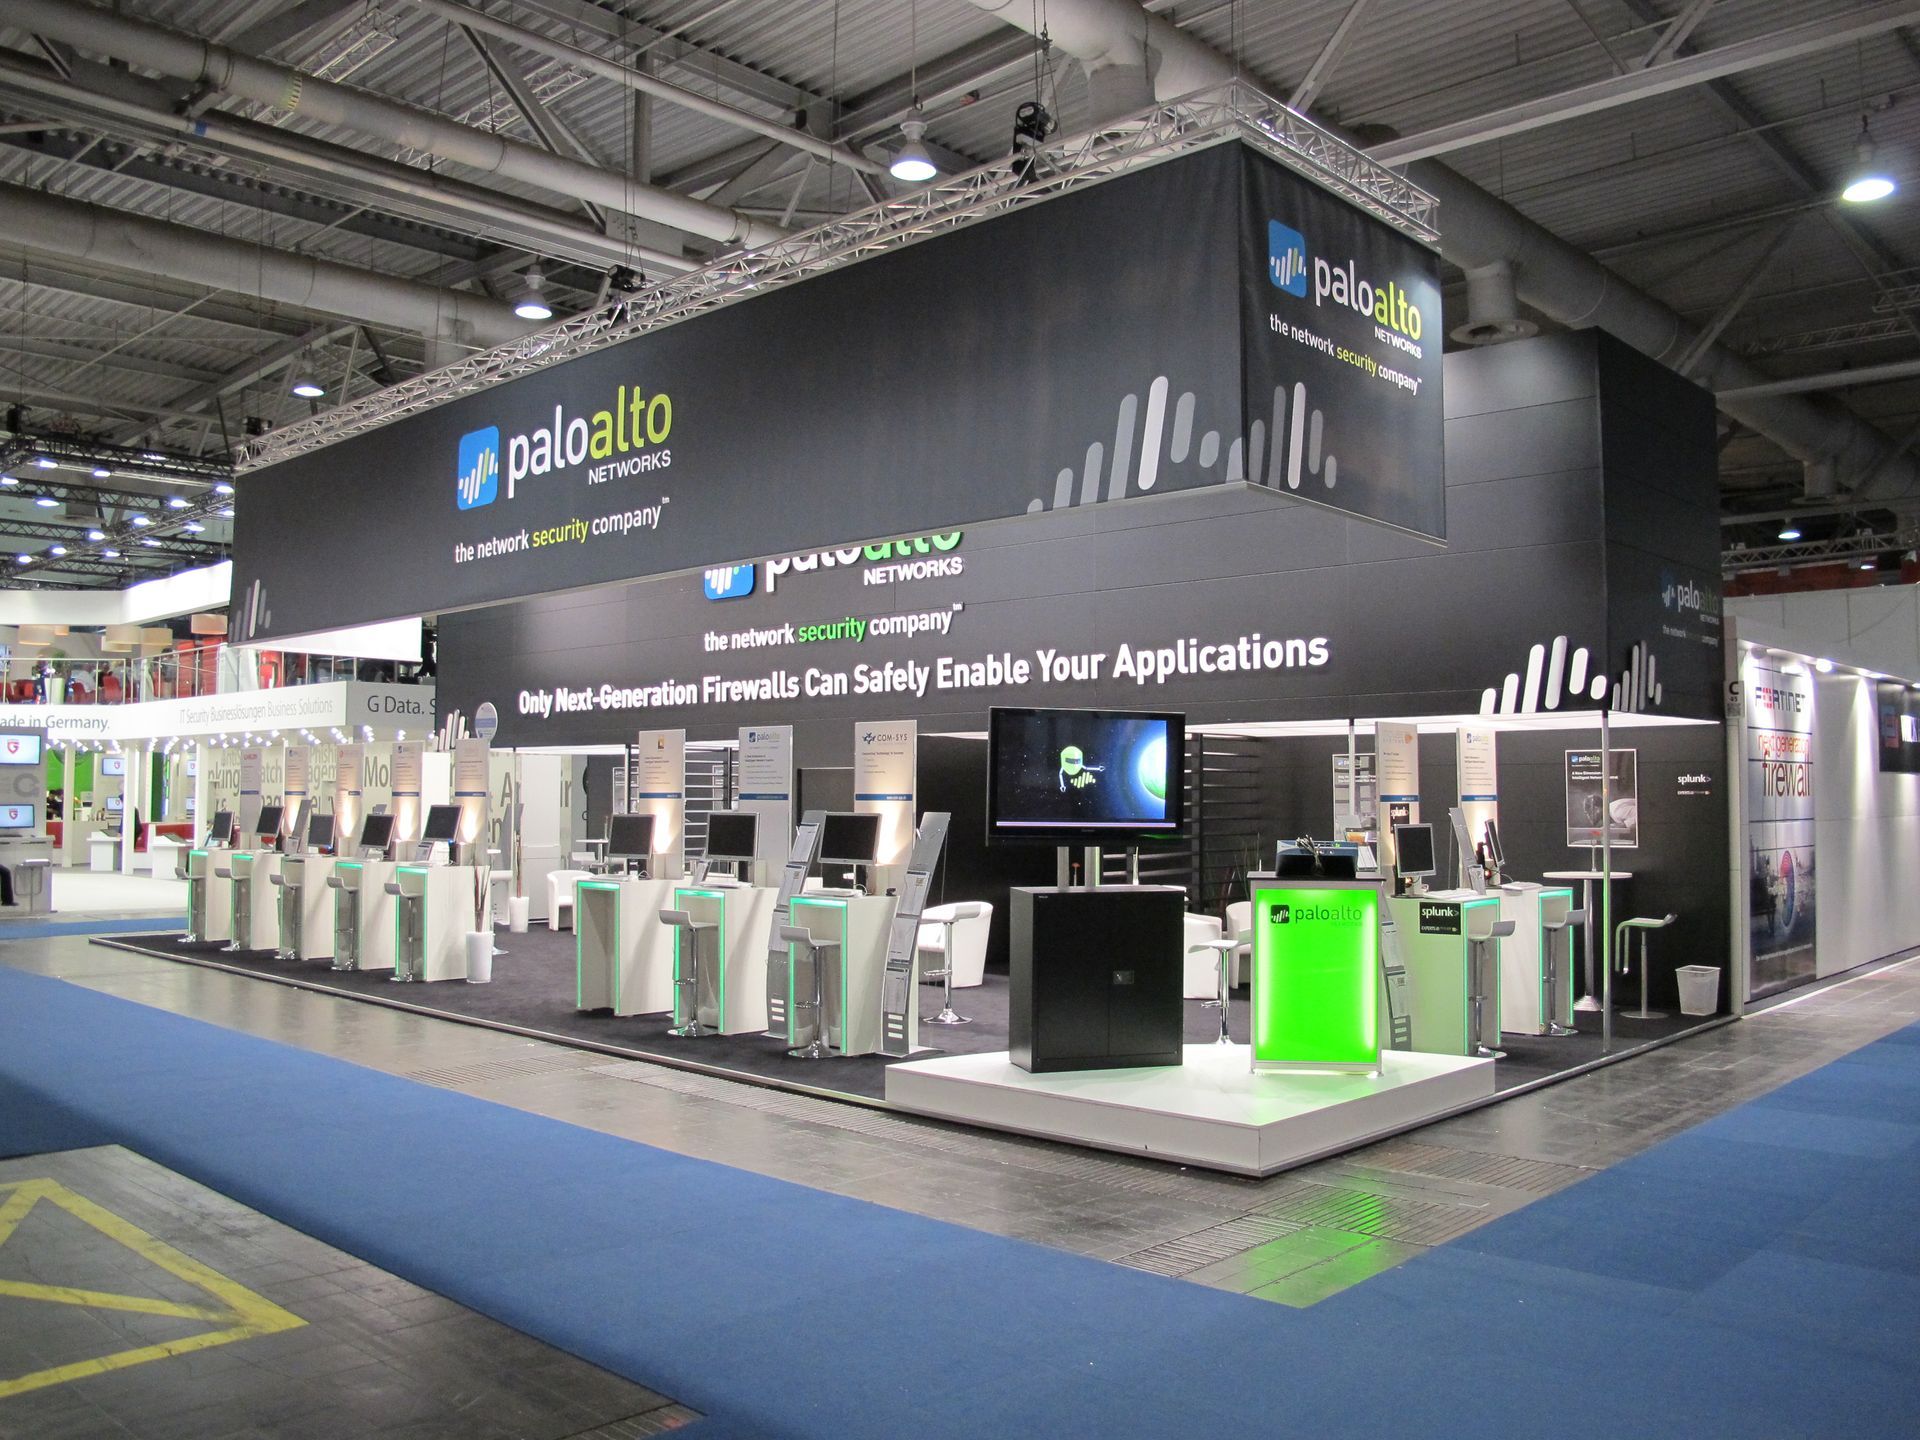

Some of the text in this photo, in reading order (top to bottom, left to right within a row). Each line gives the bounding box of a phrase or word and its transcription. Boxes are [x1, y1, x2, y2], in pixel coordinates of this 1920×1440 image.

[1315, 256, 1422, 341] paloalto
[1270, 314, 1288, 336] the
[1291, 326, 1334, 356] network
[1336, 345, 1377, 377] security
[1375, 327, 1422, 359] NETWORKS
[508, 386, 672, 499] paloalto
[588, 450, 671, 485] NETWORKS
[455, 542, 474, 563] the
[478, 530, 529, 560] network
[532, 519, 589, 547] security
[863, 557, 963, 585] NETWORKS
[704, 632, 728, 652] the
[732, 623, 795, 649] network
[799, 617, 866, 643] security
[519, 633, 1330, 719] Only Next-Generation Firewalls Can Safely Enable Your Applications
[1729, 681, 1739, 695] C
[186, 707, 209, 727] Security
[267, 700, 298, 717] Business
[297, 696, 333, 716] Solutions
[367, 695, 380, 713] G
[384, 695, 426, 715] Data.
[1755, 686, 1806, 713] FORTINET
[46, 715, 110, 732] Germany.
[877, 733, 908, 741] COM-SYS
[1762, 749, 1811, 797] firewall
[1295, 904, 1362, 923] paloalto
